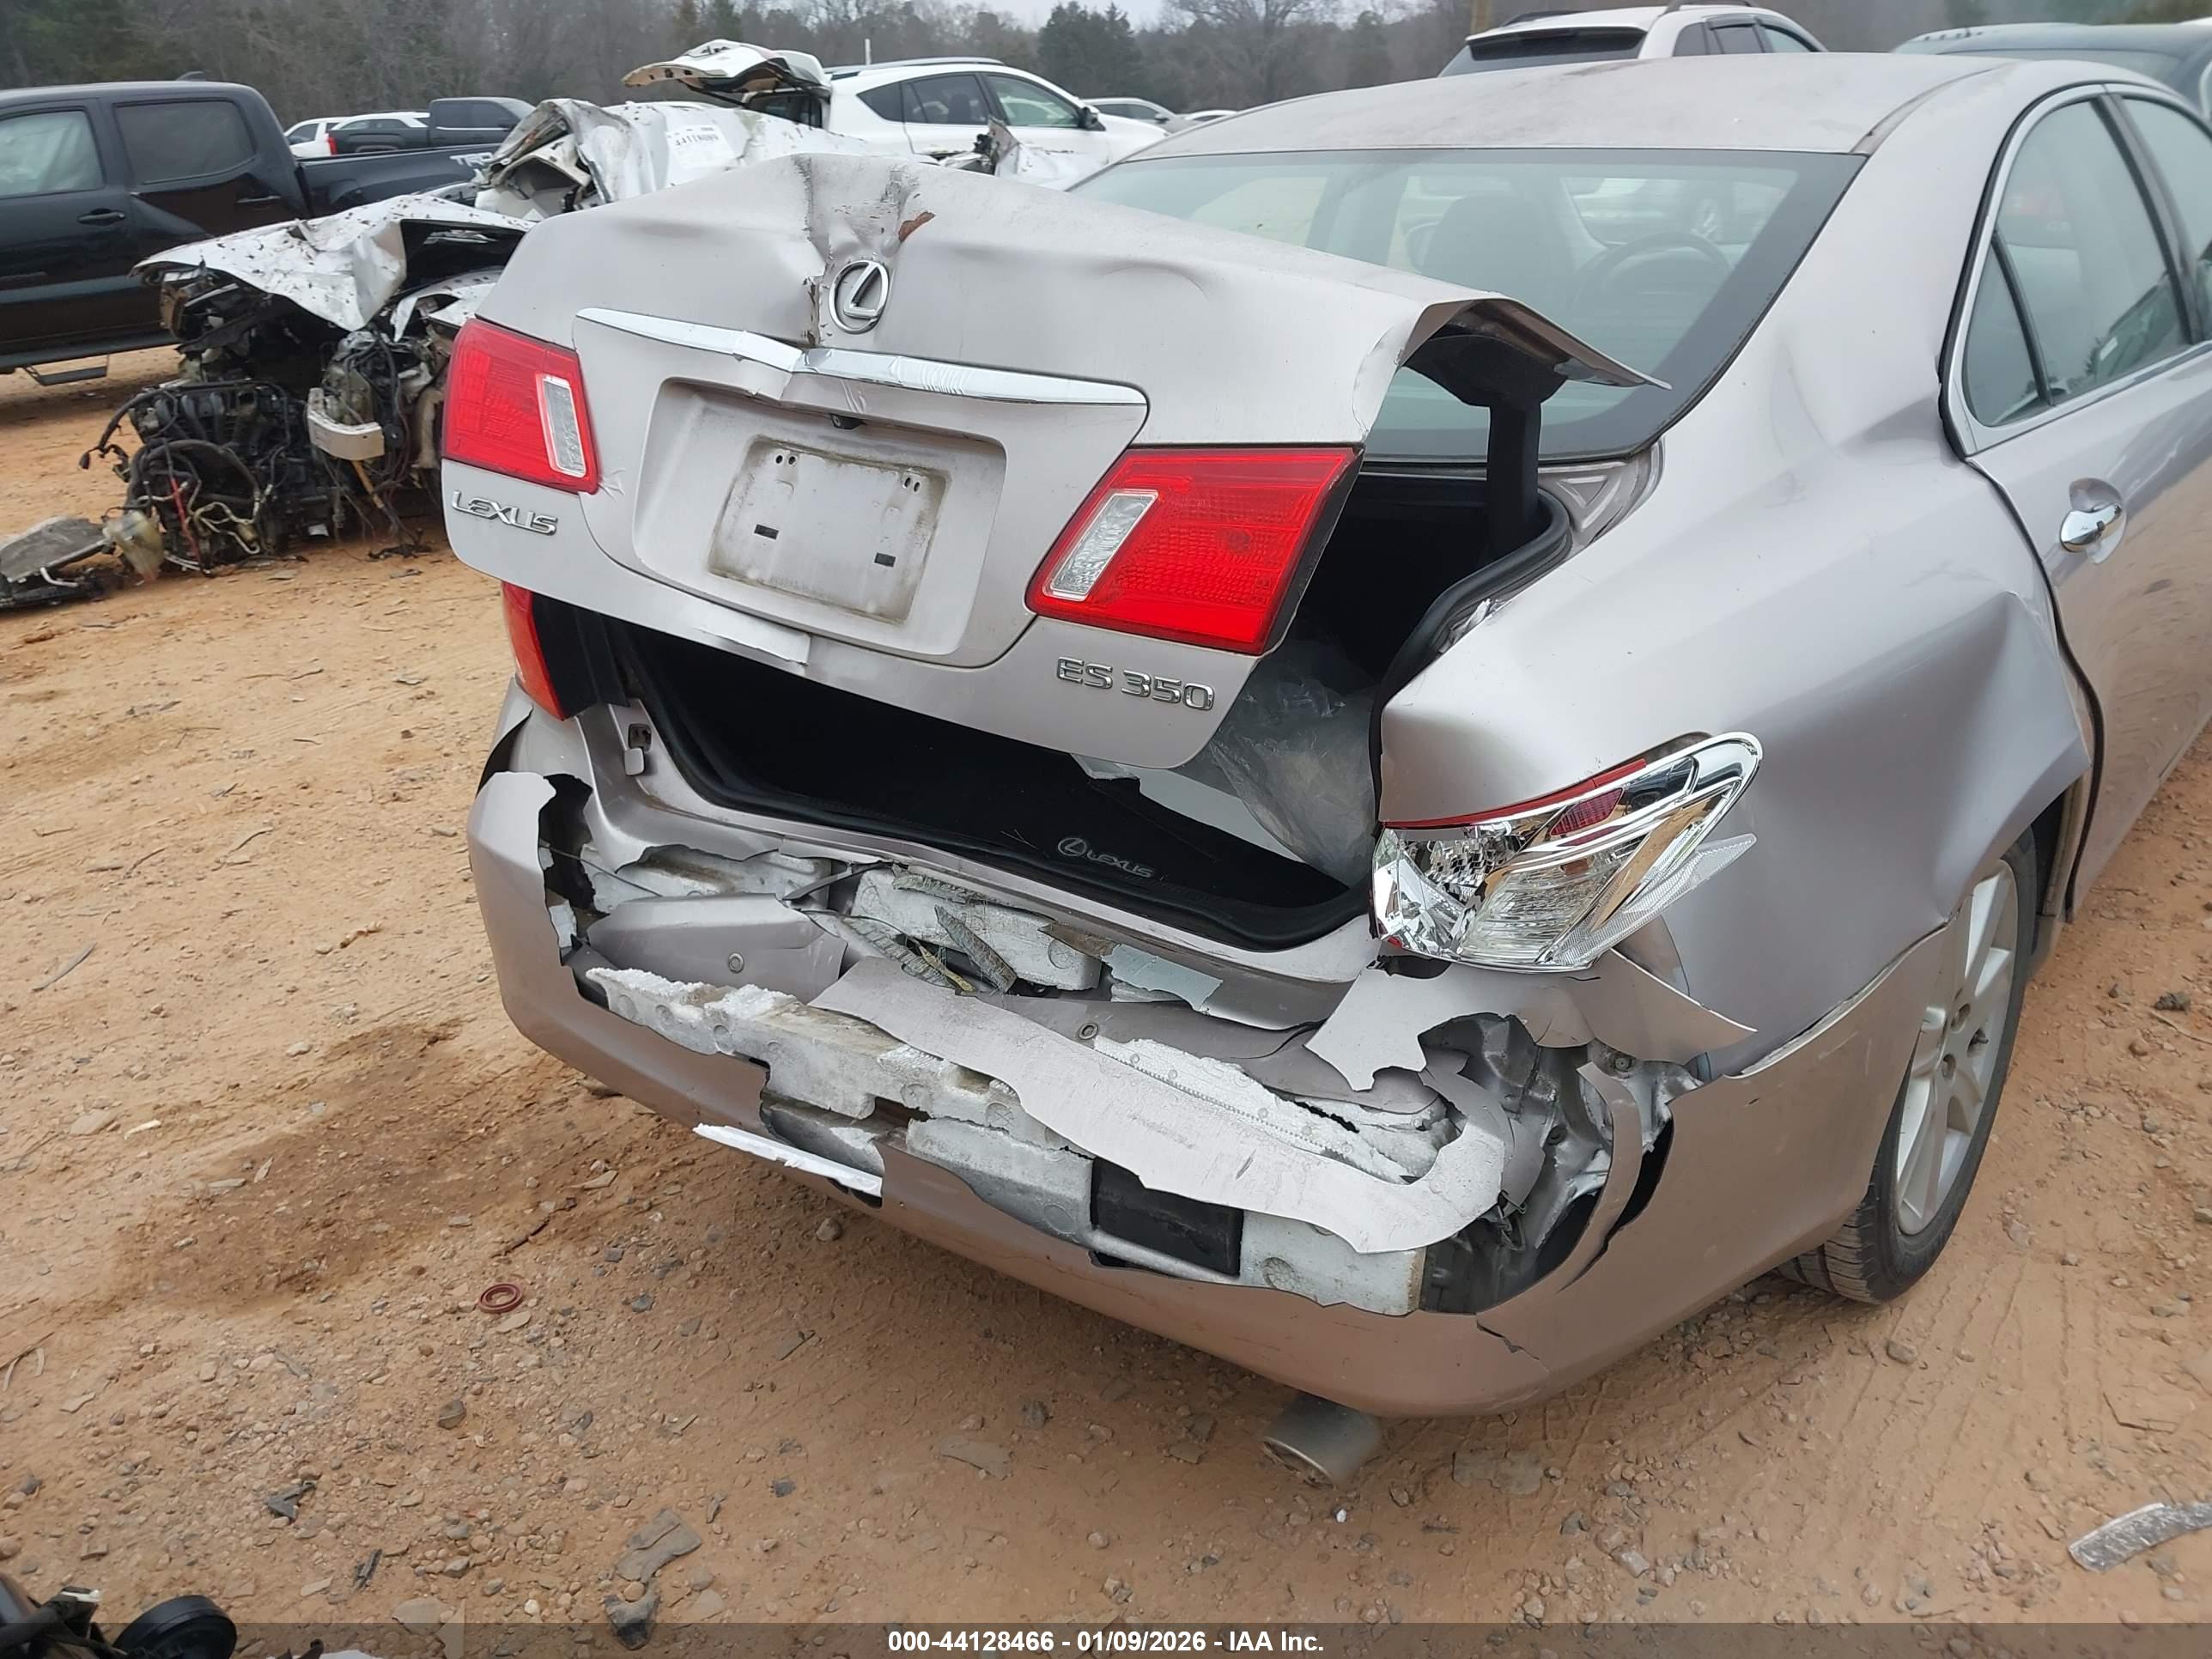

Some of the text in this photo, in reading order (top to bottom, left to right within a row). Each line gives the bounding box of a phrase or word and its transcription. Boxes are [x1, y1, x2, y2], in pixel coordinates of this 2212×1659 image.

[452, 490, 557, 536] LEXUS
[1056, 656, 1215, 711] ES 350
[1086, 849, 1154, 878] LEXUS
